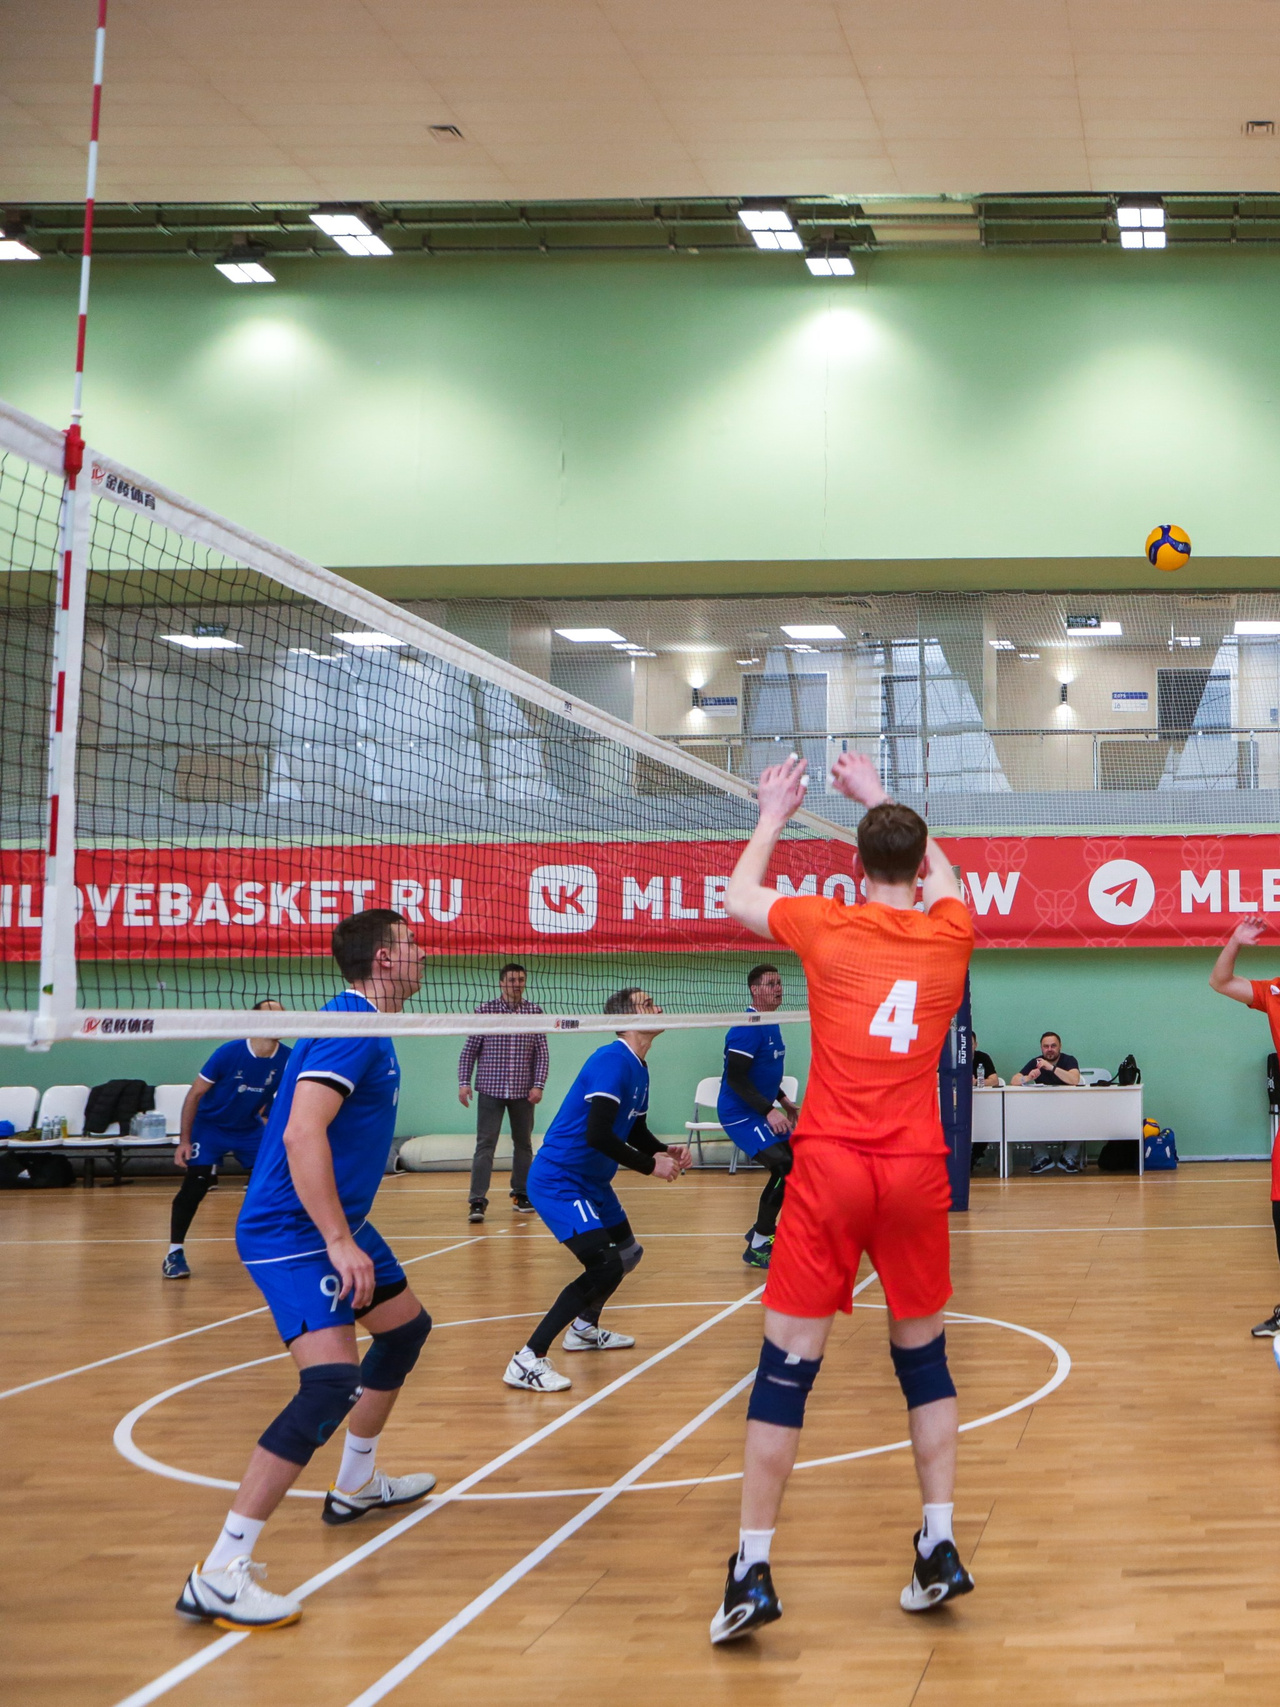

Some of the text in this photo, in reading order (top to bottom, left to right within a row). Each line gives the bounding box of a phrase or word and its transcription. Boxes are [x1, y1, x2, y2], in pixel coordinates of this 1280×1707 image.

[0, 878, 463, 927] ILVEBASKETRU
[622, 871, 1020, 920] MLBMOW
[868, 979, 919, 1054] 4
[319, 1274, 340, 1312] 9
